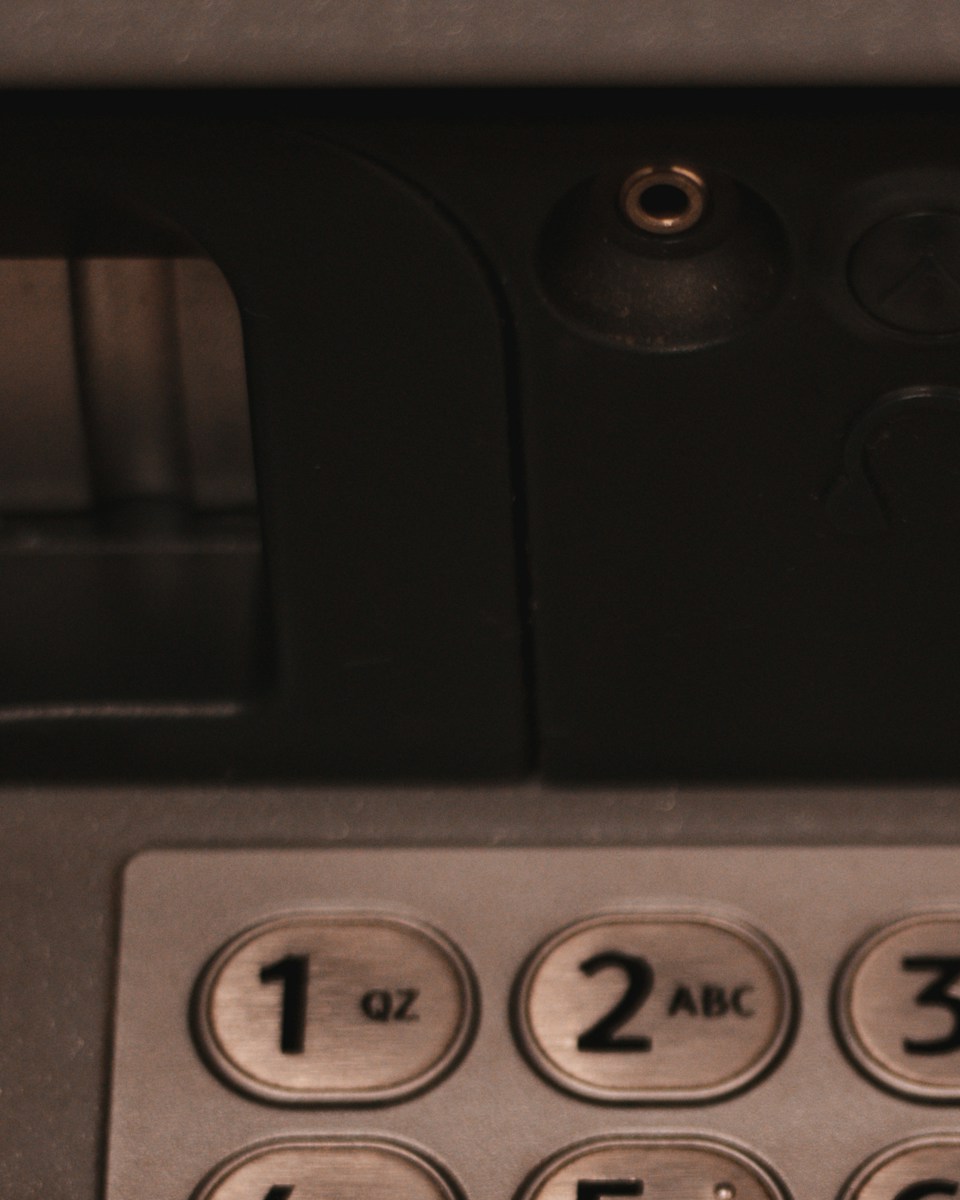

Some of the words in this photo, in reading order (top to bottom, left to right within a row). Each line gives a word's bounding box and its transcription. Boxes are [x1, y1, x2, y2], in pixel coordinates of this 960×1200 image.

[259, 953, 311, 1056] 1
[361, 988, 421, 1022] QZ
[576, 950, 655, 1053] 2
[667, 984, 757, 1018] ABC
